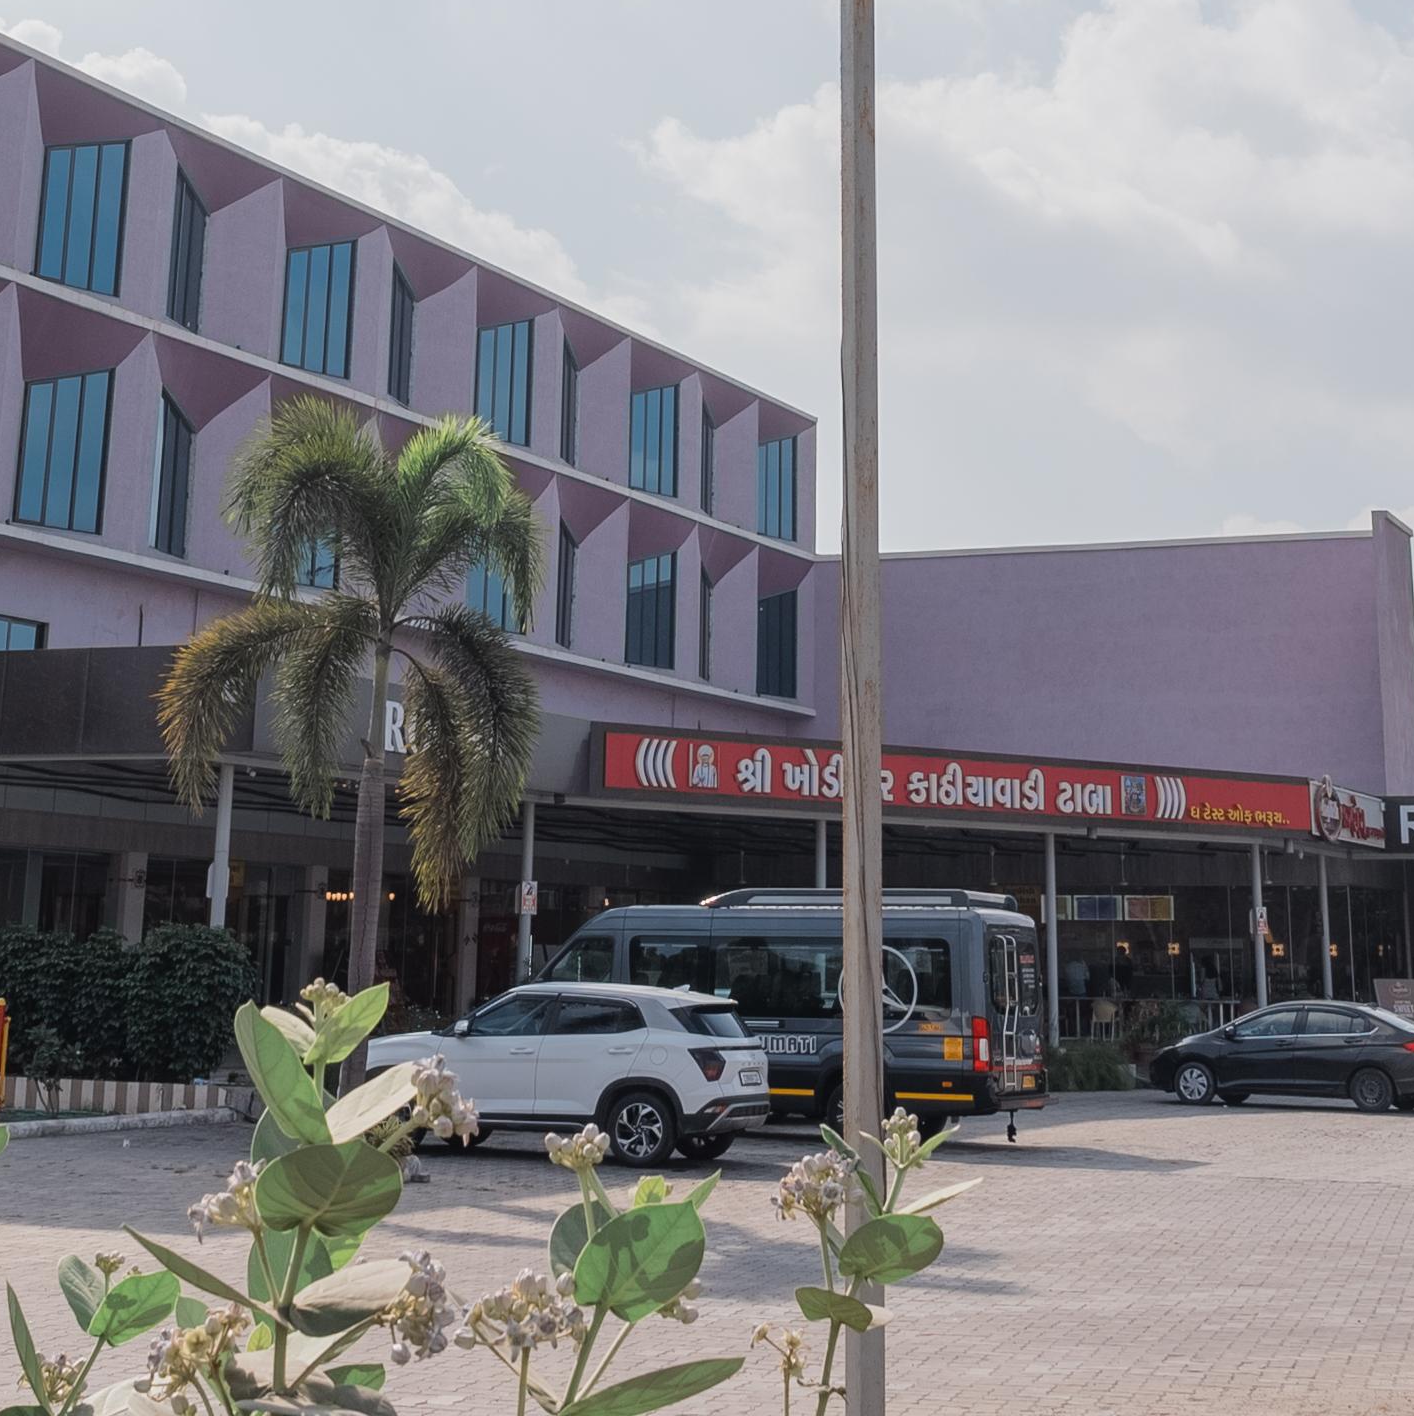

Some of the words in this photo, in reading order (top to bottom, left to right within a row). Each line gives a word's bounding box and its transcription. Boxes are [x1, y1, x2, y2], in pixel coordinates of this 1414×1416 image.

[737, 747, 772, 794] શ્રી
[782, 748, 895, 802] ખોડીર
[1056, 781, 1112, 814] ઢાબા
